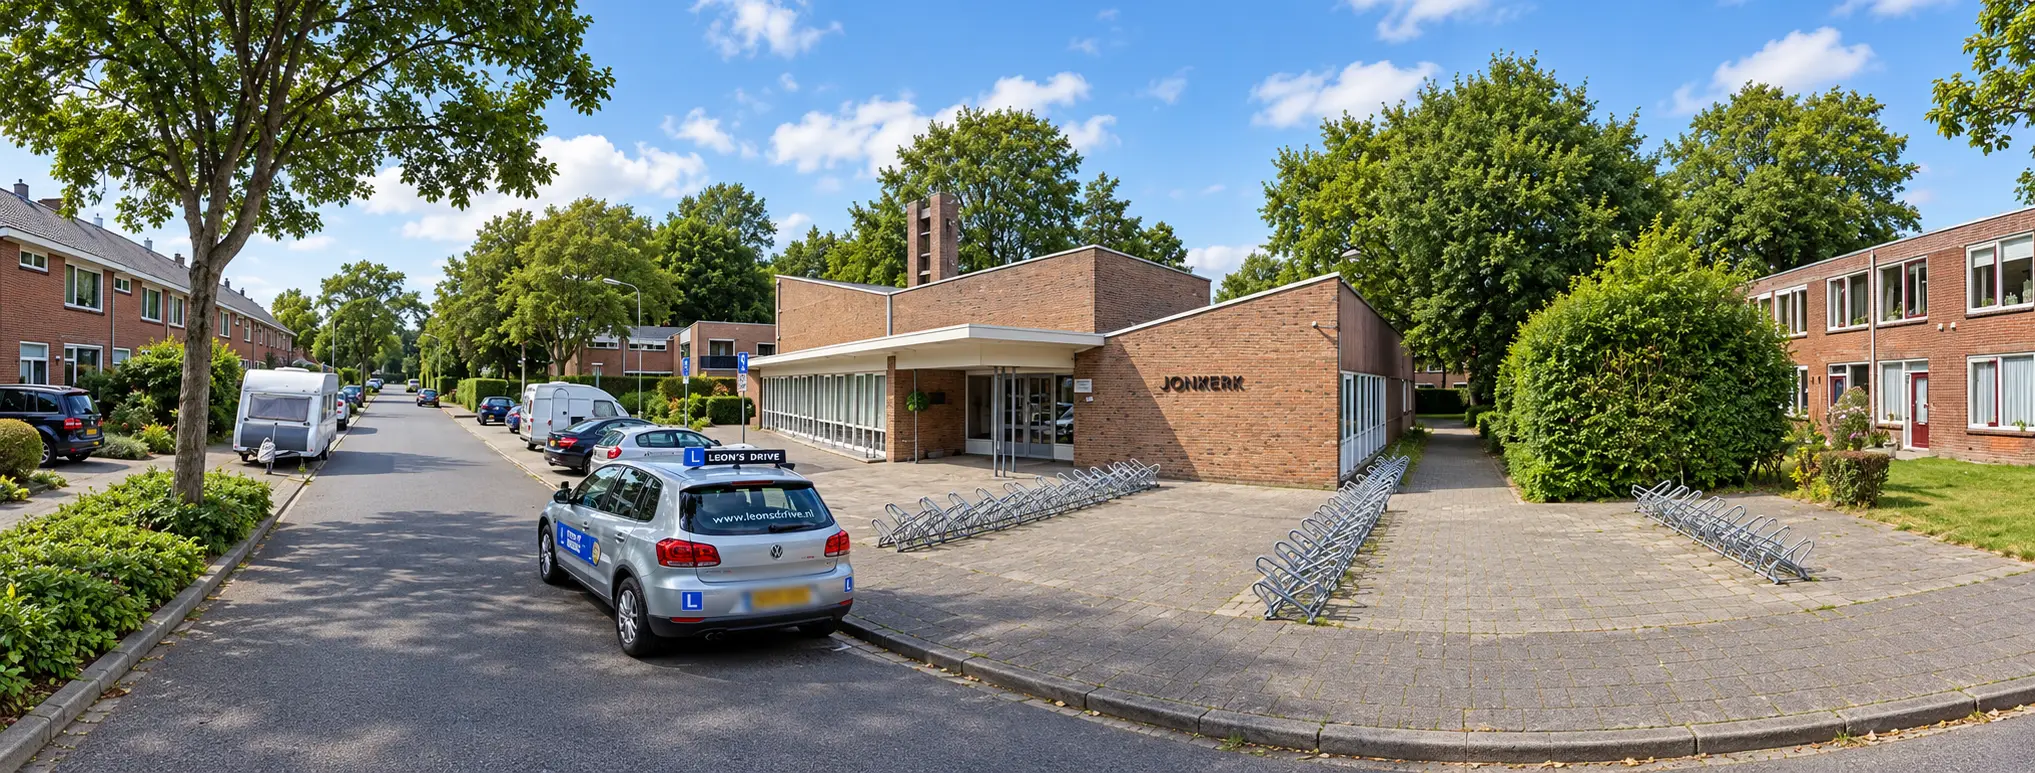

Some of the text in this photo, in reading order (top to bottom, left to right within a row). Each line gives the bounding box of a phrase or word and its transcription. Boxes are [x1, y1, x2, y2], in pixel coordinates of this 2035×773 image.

[1160, 375, 1246, 393] JONKERK
[691, 450, 700, 463] L
[708, 452, 780, 462] LEON'S DRIVE
[687, 593, 698, 608] L
